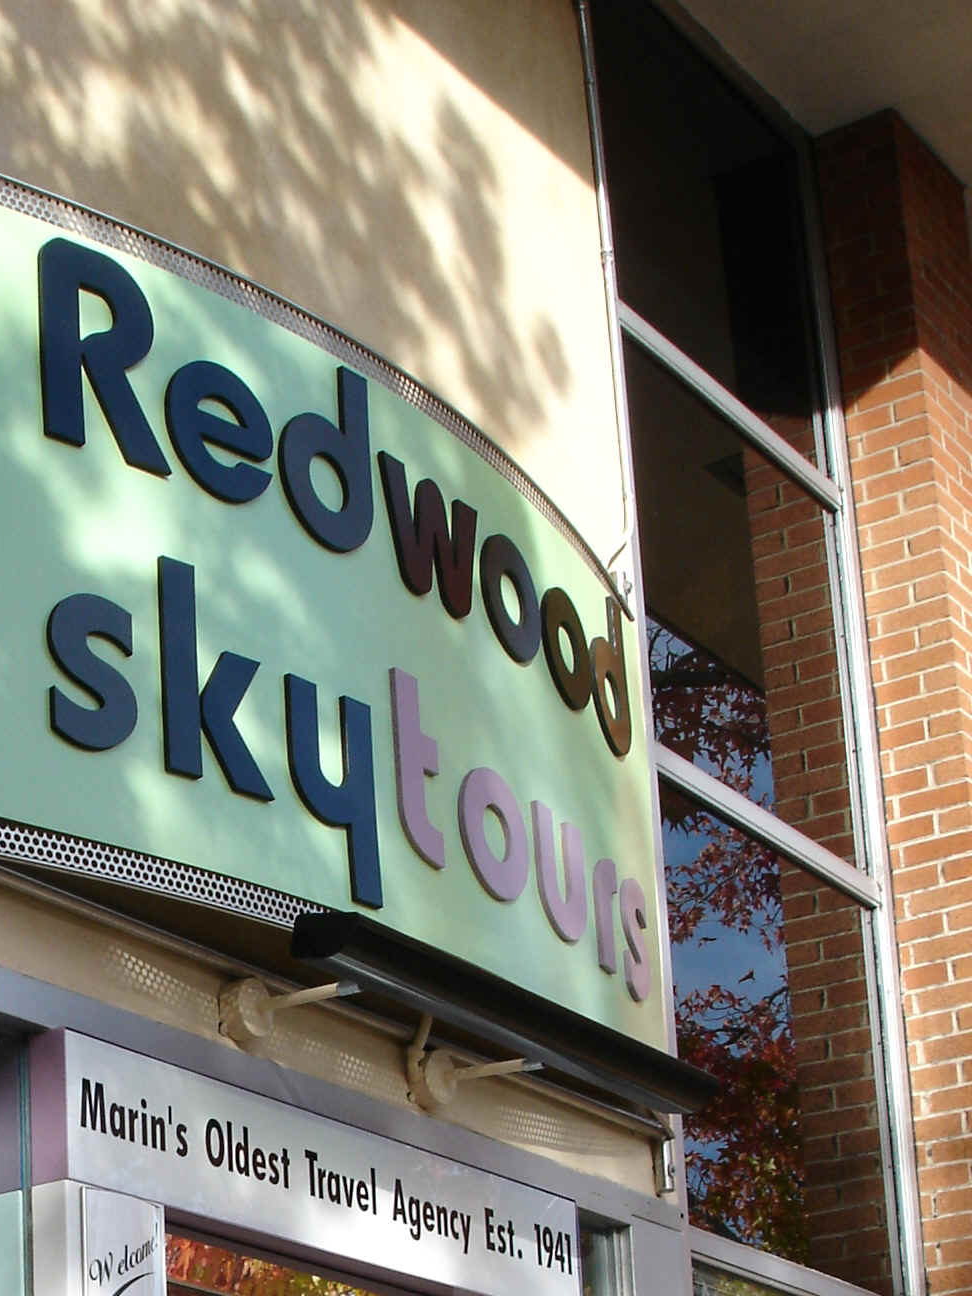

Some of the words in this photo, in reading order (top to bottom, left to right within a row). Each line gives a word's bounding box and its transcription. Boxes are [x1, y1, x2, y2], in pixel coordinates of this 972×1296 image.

[37, 236, 631, 757] Redwood
[80, 1077, 188, 1158] Marin's
[205, 1119, 289, 1189] Oldest
[305, 1149, 376, 1216] Travel
[393, 1179, 471, 1254] Agency
[484, 1208, 522, 1259] Est.
[534, 1223, 573, 1275] 1941
[89, 1222, 159, 1287] Welcome!
